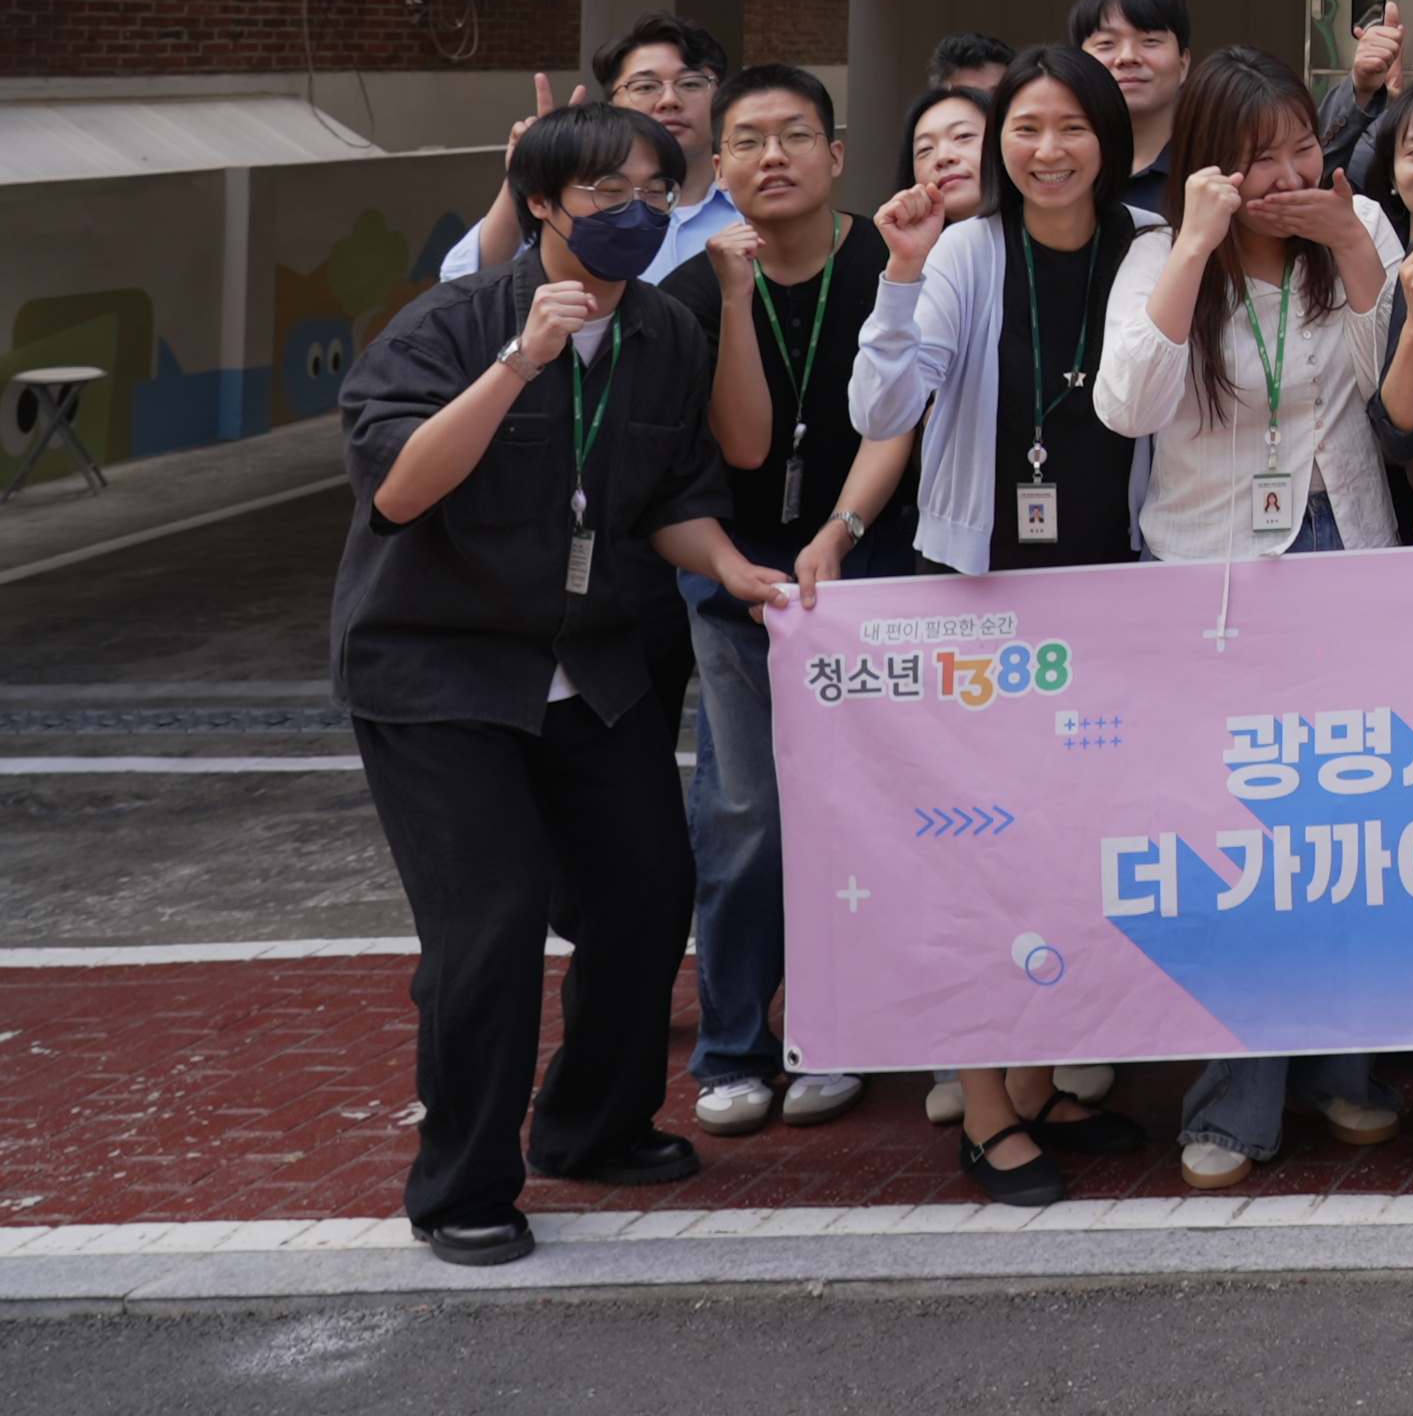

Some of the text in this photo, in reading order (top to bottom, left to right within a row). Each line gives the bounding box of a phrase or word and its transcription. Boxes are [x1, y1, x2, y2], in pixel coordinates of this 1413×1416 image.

[864, 615, 1015, 641] 내 편이 필요한 순간
[808, 643, 1069, 707] 청소년 1388
[1101, 831, 1179, 918] 더
